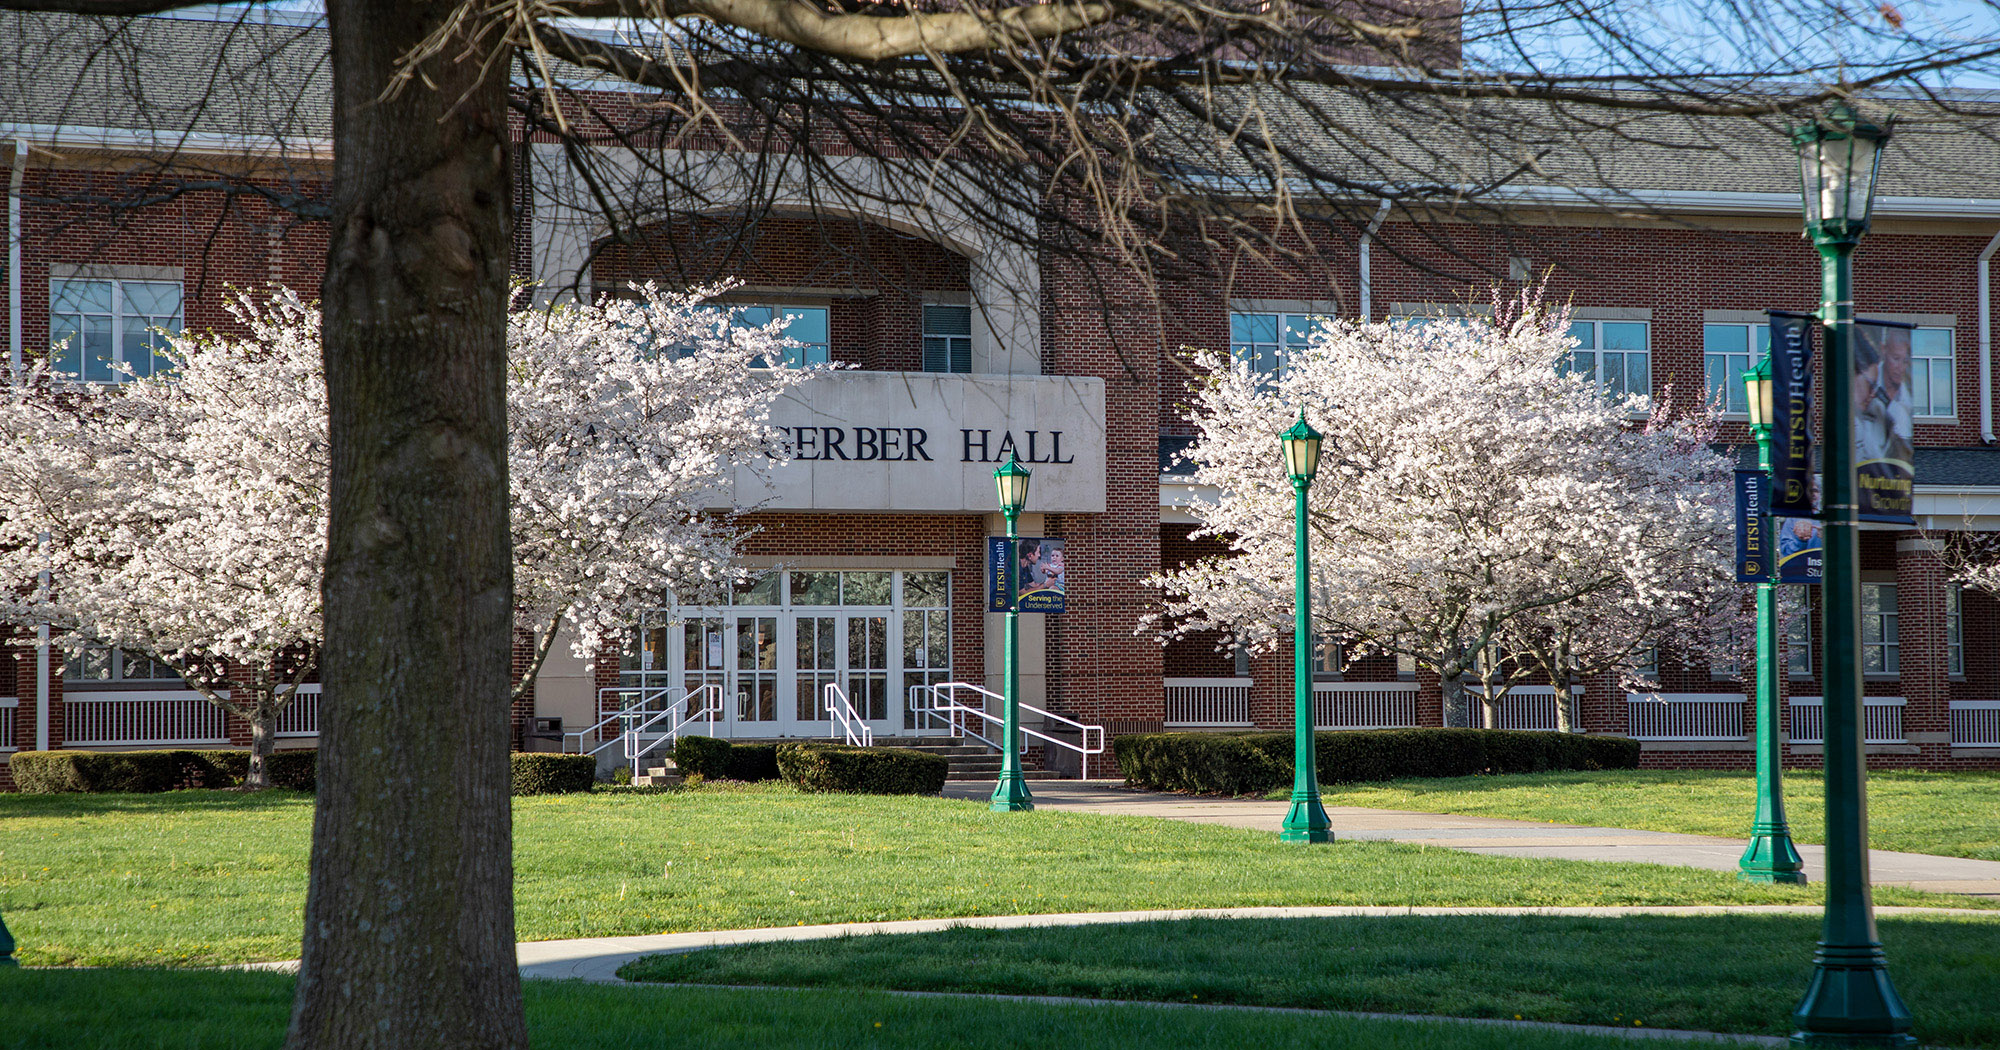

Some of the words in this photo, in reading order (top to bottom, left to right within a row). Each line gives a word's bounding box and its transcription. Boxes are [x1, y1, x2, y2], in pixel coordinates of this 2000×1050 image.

[1786, 326, 1805, 459] ETSUHealth
[761, 426, 934, 461] GERBER
[959, 428, 1075, 464] HALL
[1859, 473, 1912, 494] Nurturing
[1871, 493, 1912, 511] Growth
[1745, 477, 1759, 551] ETSUHealth
[995, 541, 1005, 591] ETSUHealth
[1028, 594, 1052, 603] Serving
